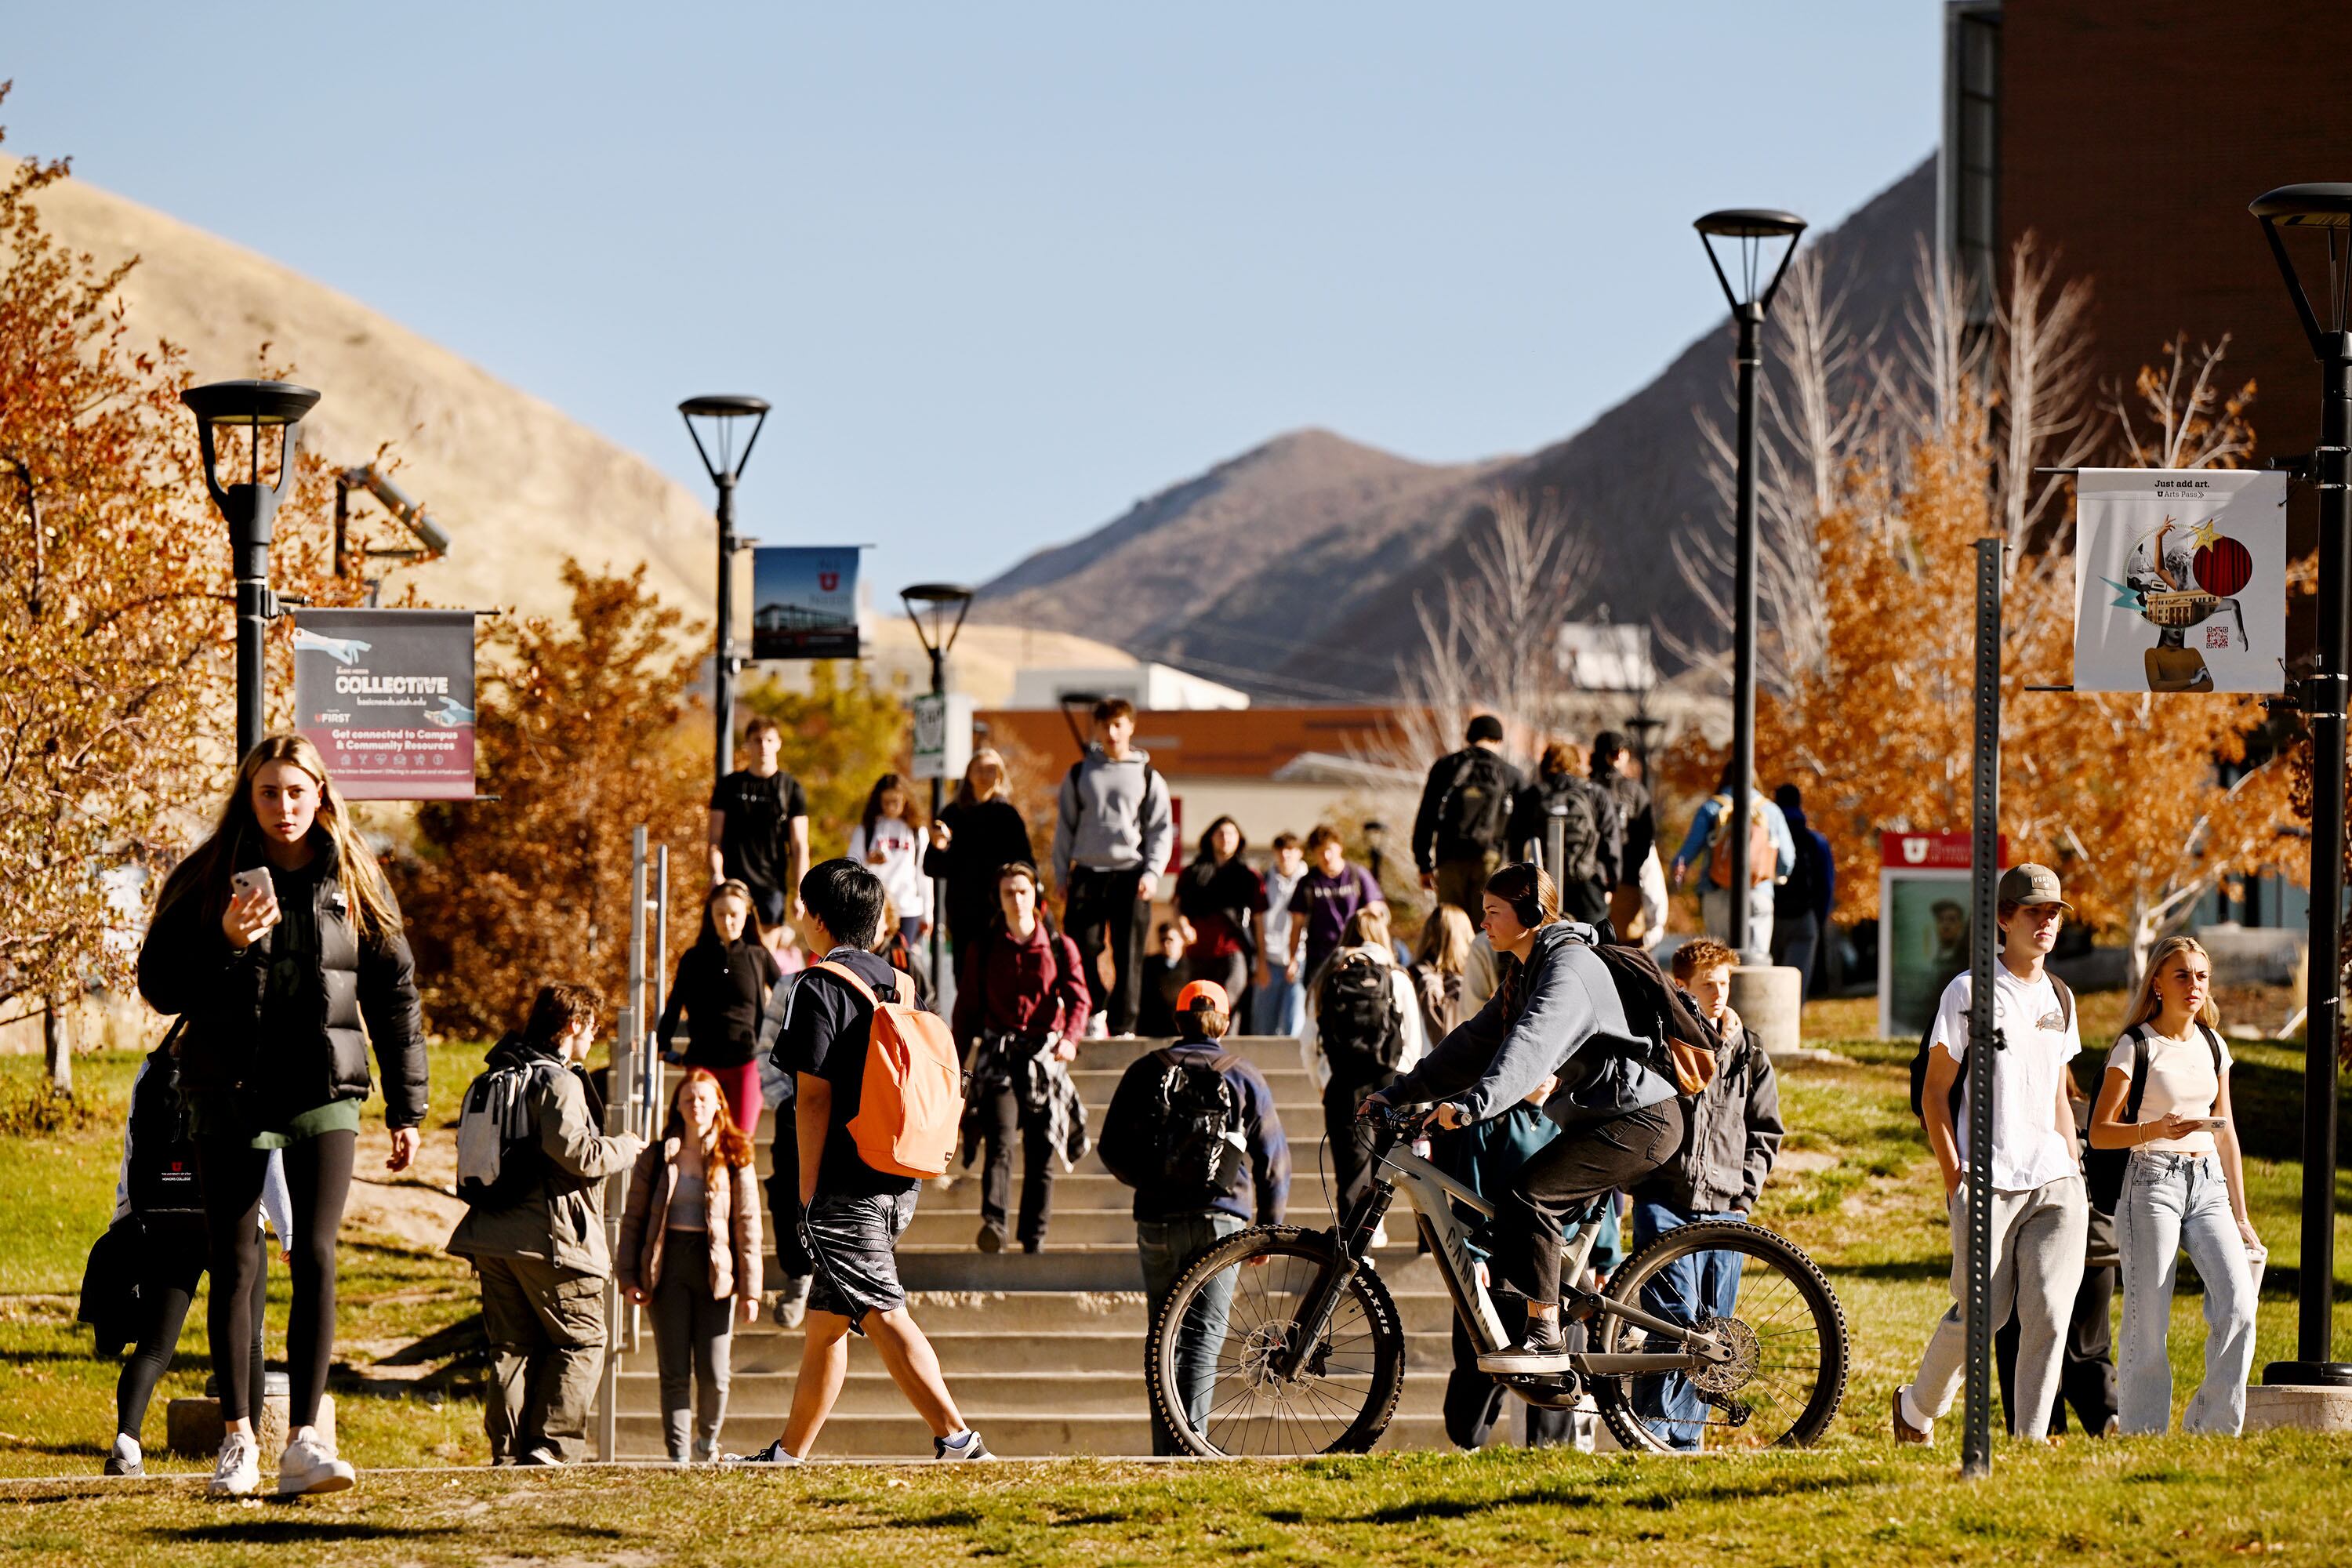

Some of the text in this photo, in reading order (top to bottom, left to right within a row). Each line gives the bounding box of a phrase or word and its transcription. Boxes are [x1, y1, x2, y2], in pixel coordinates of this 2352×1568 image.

[336, 676, 448, 695] COLLECTIVE
[332, 729, 458, 742] Get connected to Campus
[336, 740, 456, 753] & Community Resources
[1354, 1276, 1391, 1334] MAXXIS
